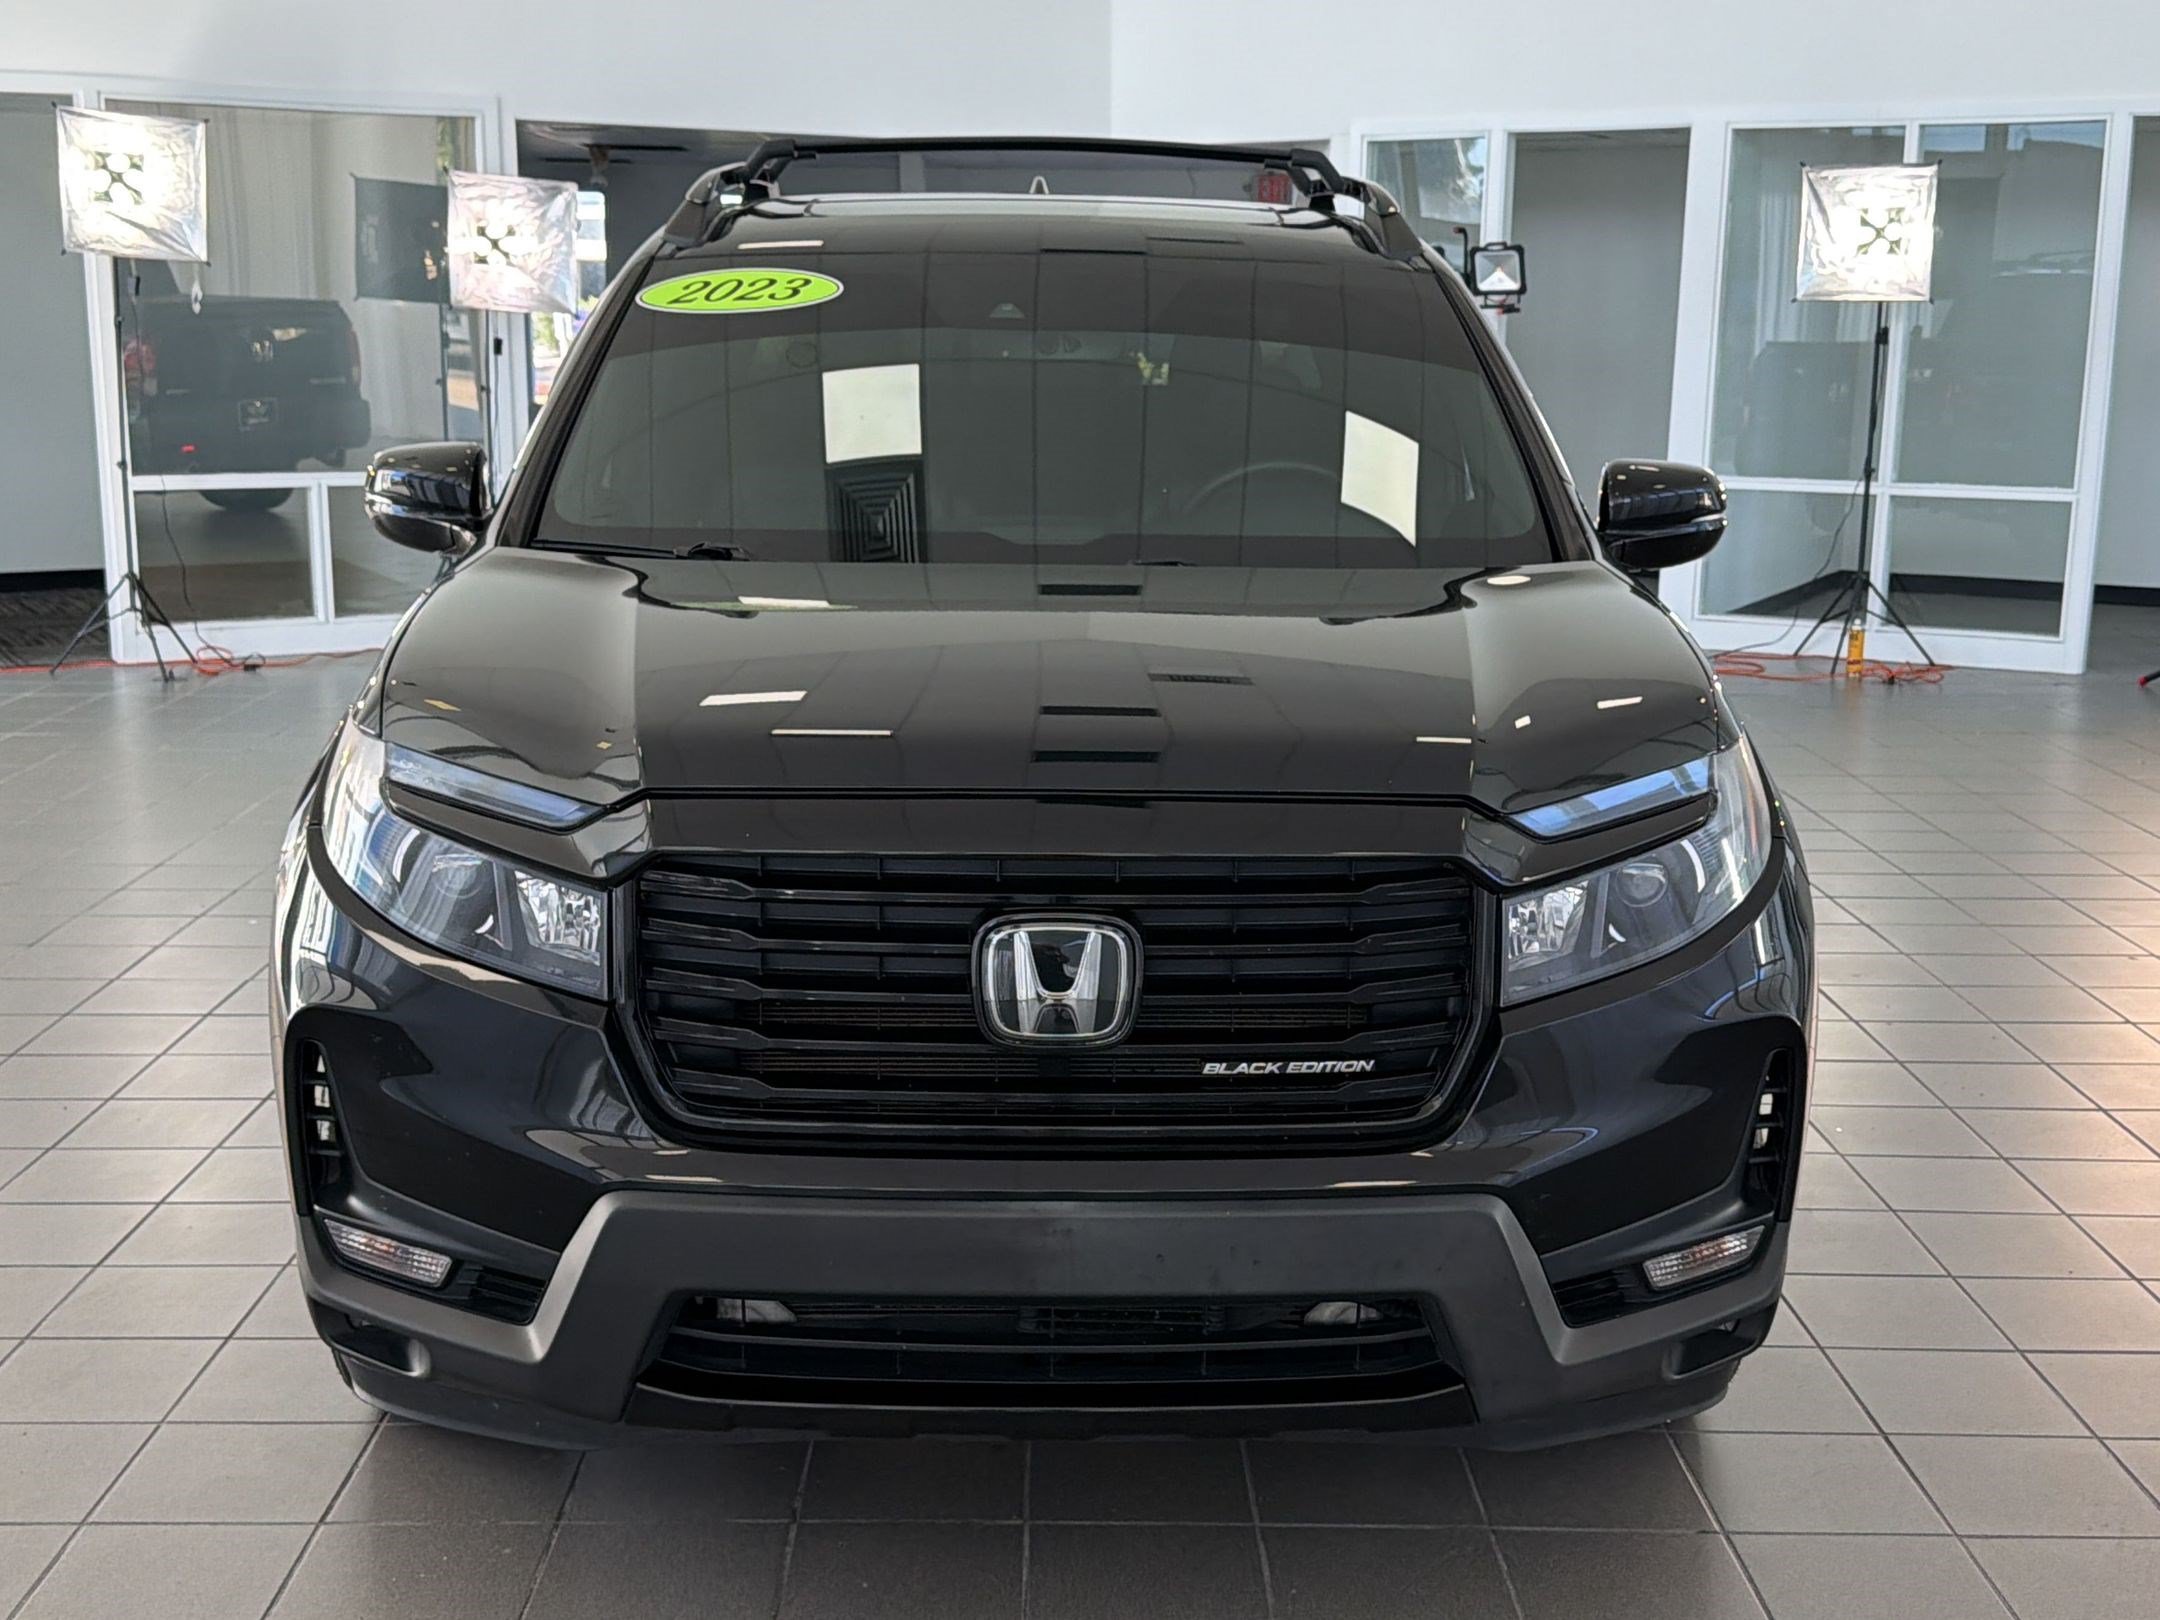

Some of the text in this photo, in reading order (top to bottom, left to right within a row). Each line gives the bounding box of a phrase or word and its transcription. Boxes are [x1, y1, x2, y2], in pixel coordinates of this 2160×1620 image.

[667, 278, 812, 305] 2023
[1202, 1060, 1375, 1075] BLACK EDITION
